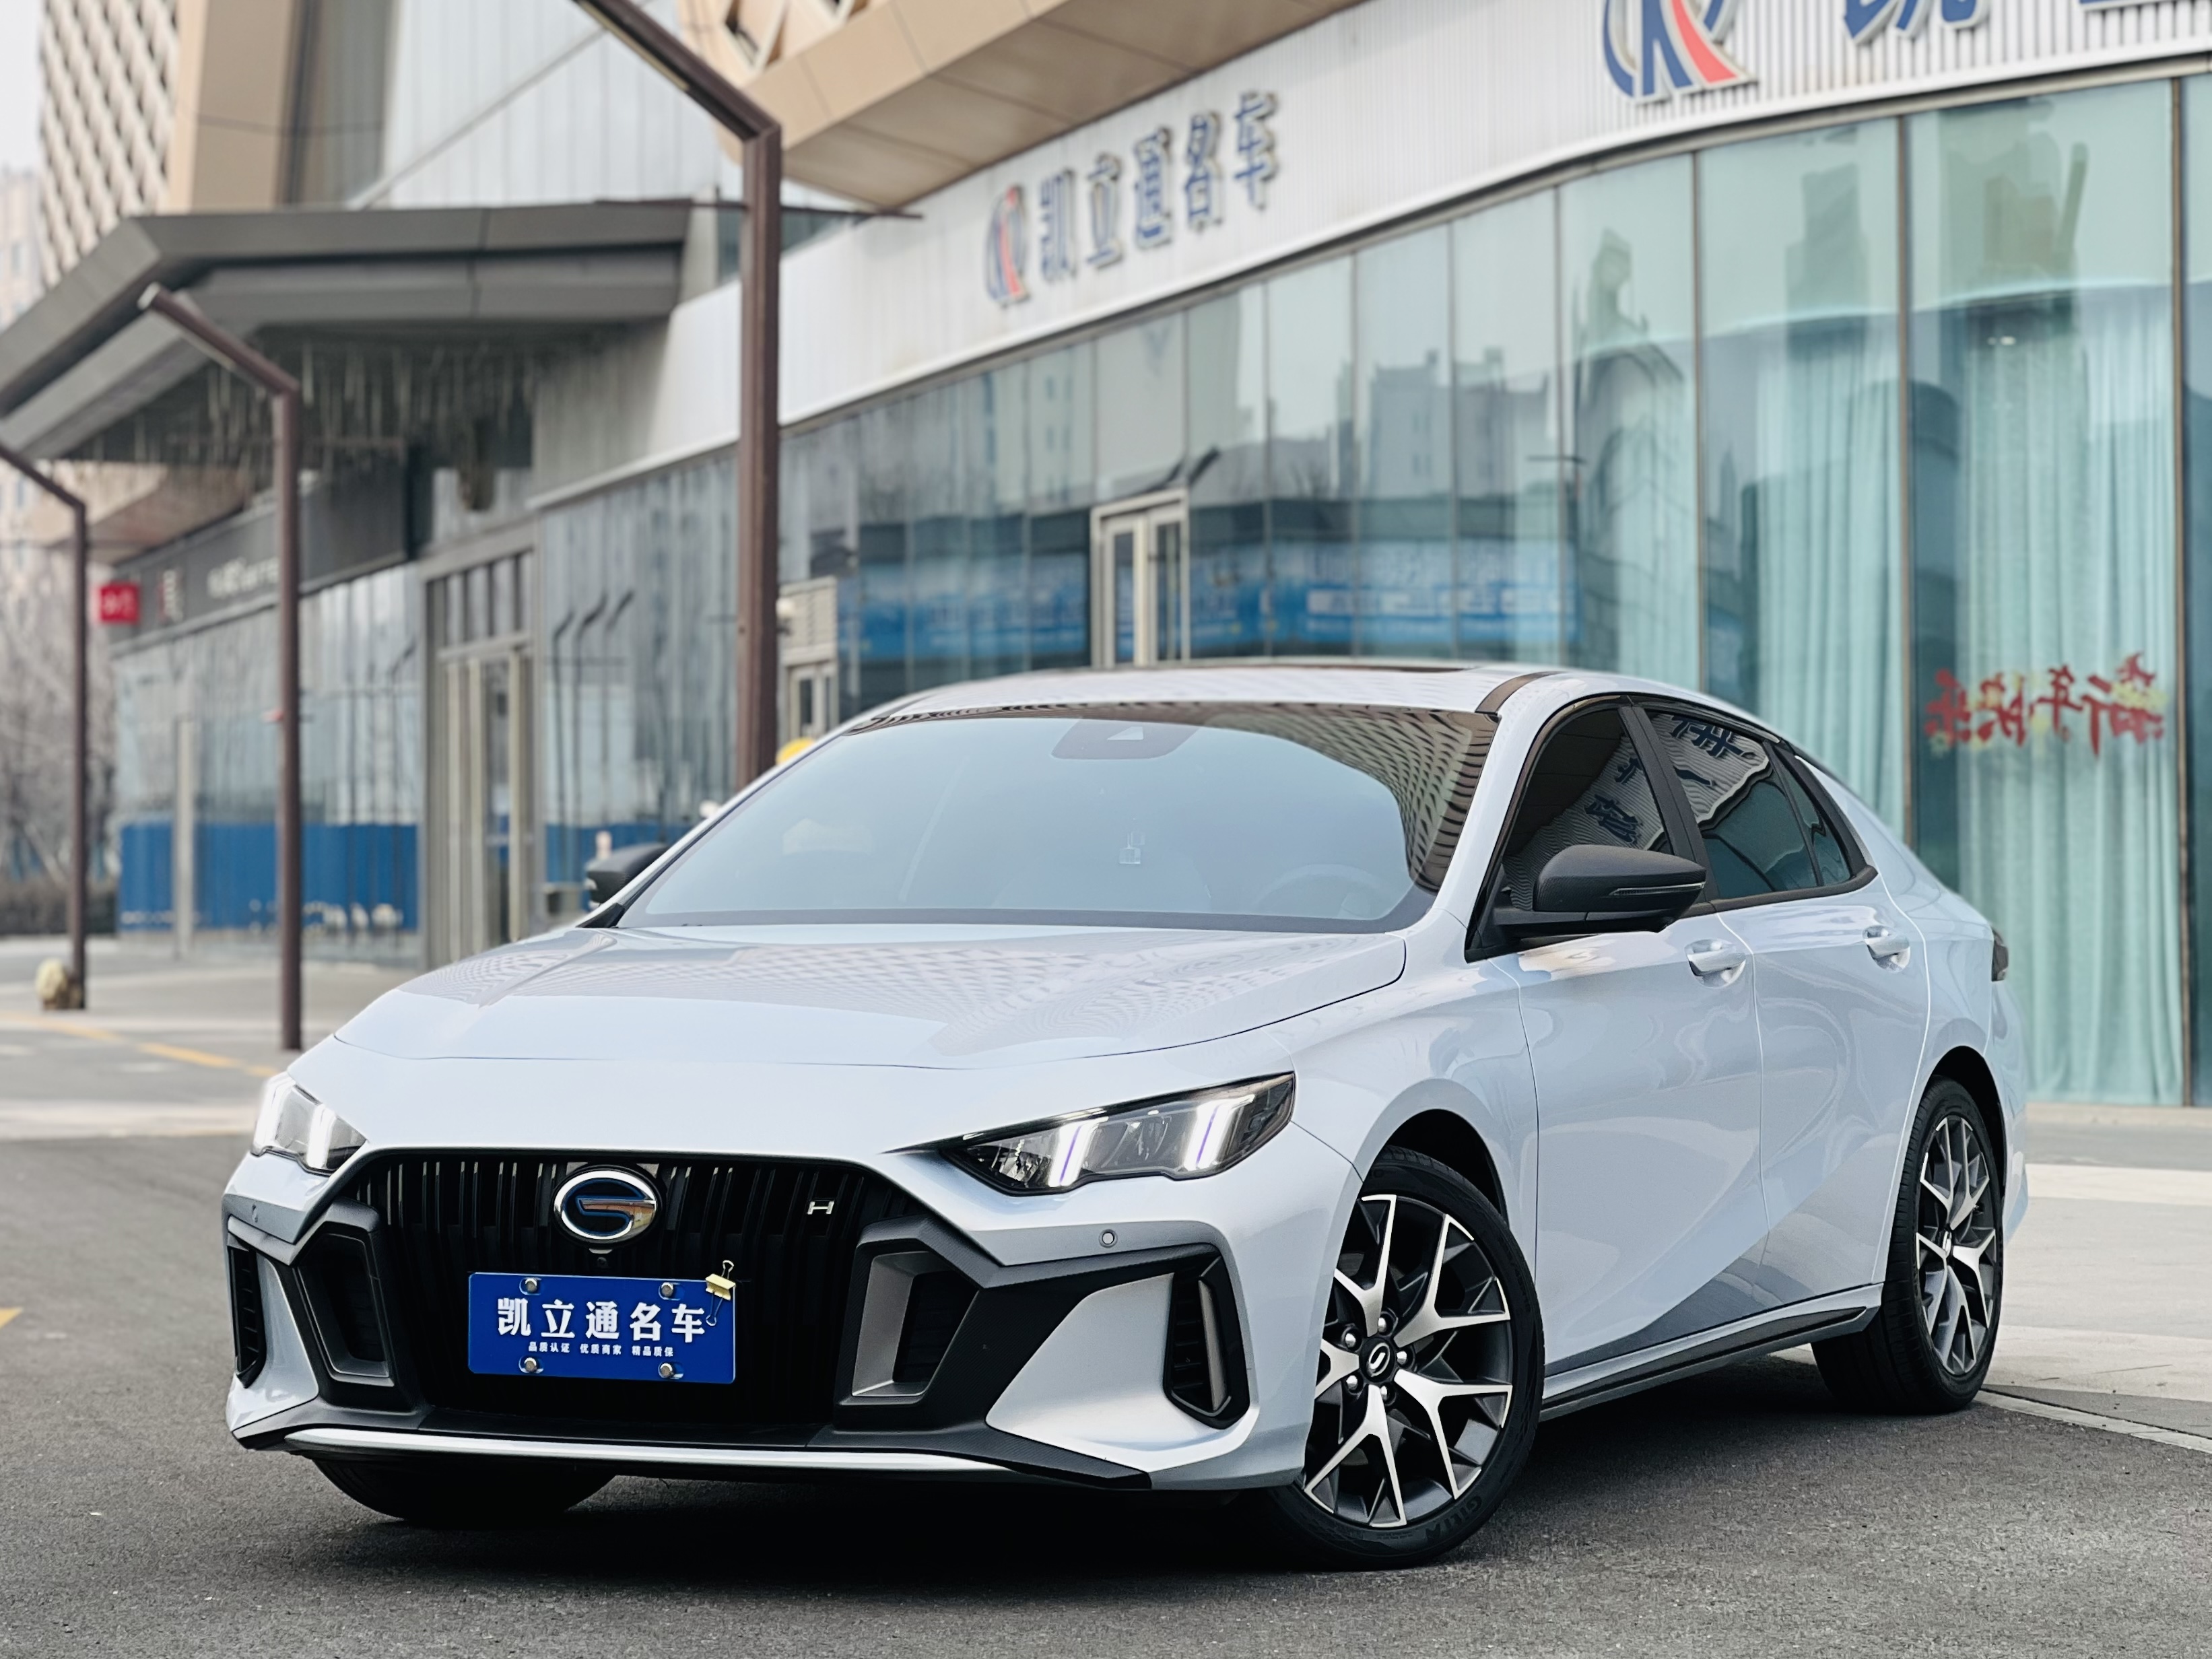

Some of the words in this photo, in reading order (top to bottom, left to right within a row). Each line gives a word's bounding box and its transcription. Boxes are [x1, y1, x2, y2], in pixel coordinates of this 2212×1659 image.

[497, 1297, 706, 1343] 凯立通名车
[528, 1341, 570, 1353] 品质认证
[580, 1343, 622, 1355] 优质商家
[632, 1345, 673, 1357] 精品质保
